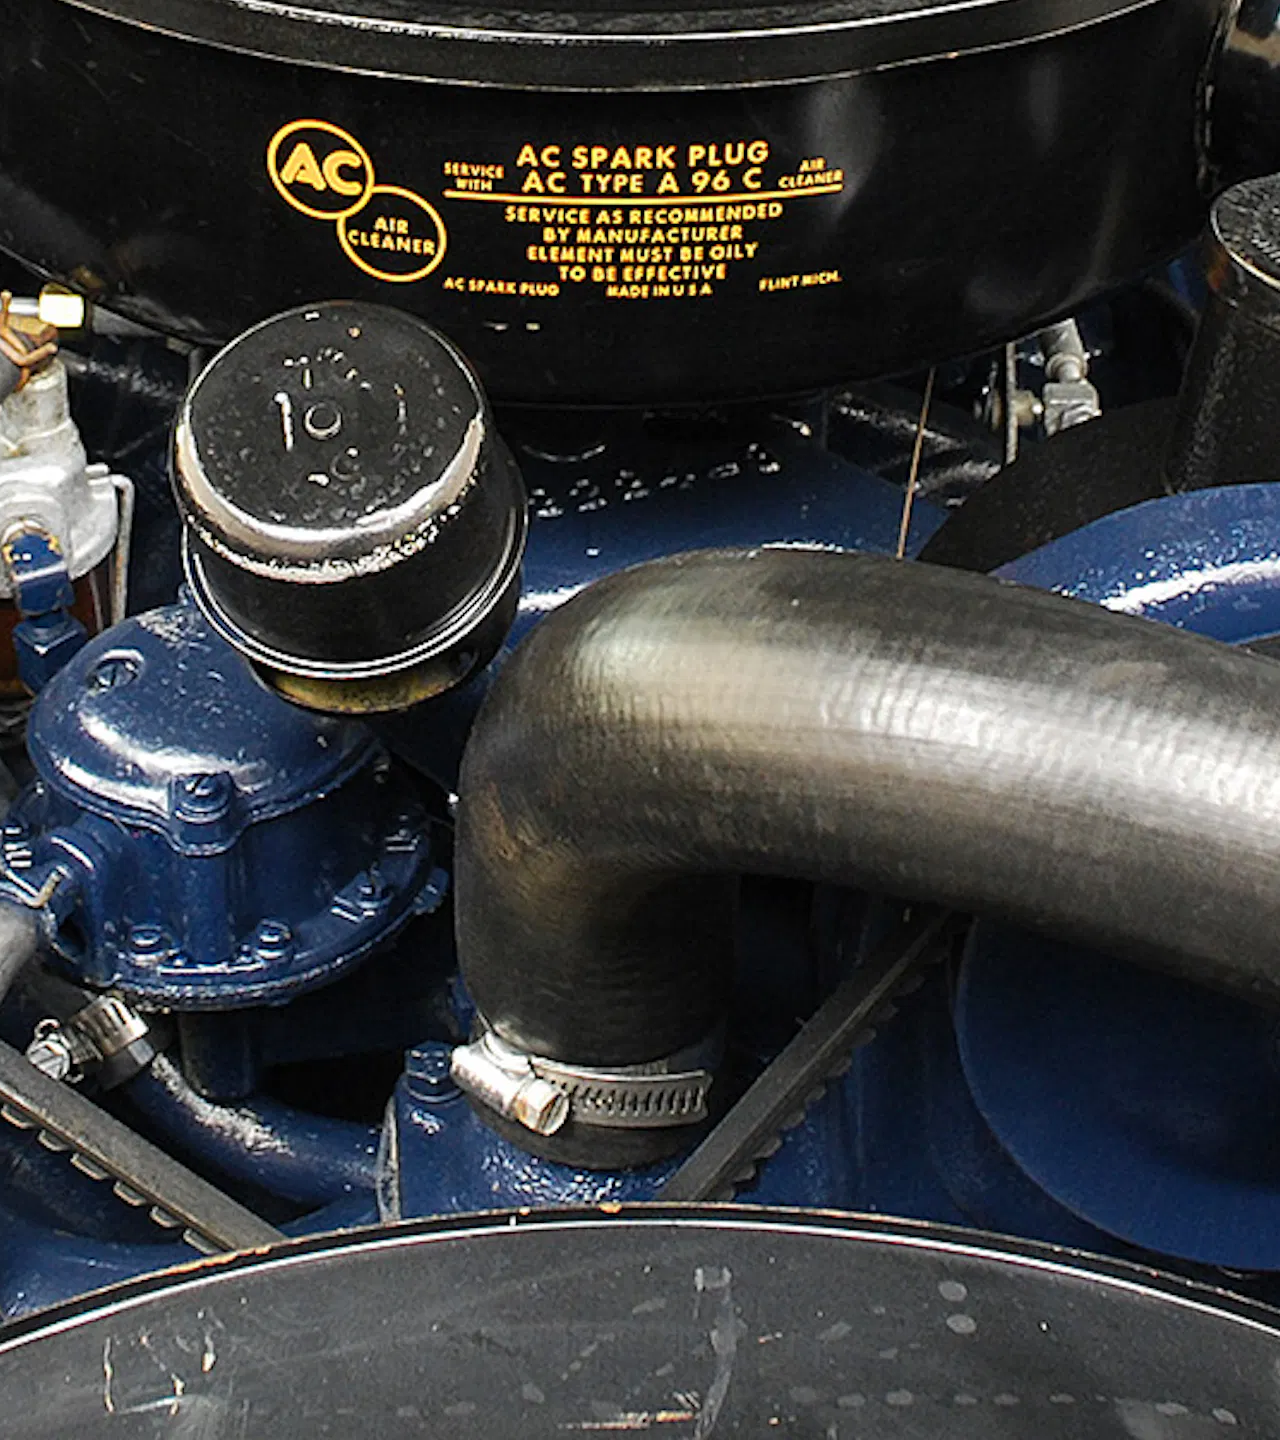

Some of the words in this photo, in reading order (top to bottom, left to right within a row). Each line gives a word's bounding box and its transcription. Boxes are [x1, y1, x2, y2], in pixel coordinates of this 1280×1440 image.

[516, 142, 561, 168] AC
[571, 144, 677, 170] SPARK
[687, 139, 770, 168] PLUG
[280, 141, 363, 197] AC
[443, 161, 505, 180] SERVICE
[798, 157, 826, 173] AIR
[454, 176, 493, 192] WITH
[521, 169, 567, 194] AC
[579, 173, 644, 194] TYPE
[656, 170, 680, 195] A
[691, 168, 731, 194] 96
[741, 166, 763, 190] C
[777, 168, 844, 190] CLEANER
[504, 205, 591, 224] SERVICE
[595, 209, 623, 225] AS
[628, 202, 783, 225] RECOMMENDED
[373, 215, 409, 235] AIR
[542, 226, 571, 243] BY
[576, 224, 744, 244] MANUFACTURER
[347, 229, 436, 256] CLEANER
[526, 245, 615, 263] ELEMENT
[619, 246, 673, 263] MUST
[679, 246, 705, 263] BE
[708, 241, 759, 261] OILY
[559, 265, 587, 282] TO
[591, 265, 618, 282] BE
[621, 262, 727, 282] EFFECTIVE
[443, 277, 466, 292] AC
[468, 277, 517, 295] SPARK
[519, 281, 560, 296] PLUG
[605, 284, 649, 299] MADE
[652, 284, 671, 297] IN
